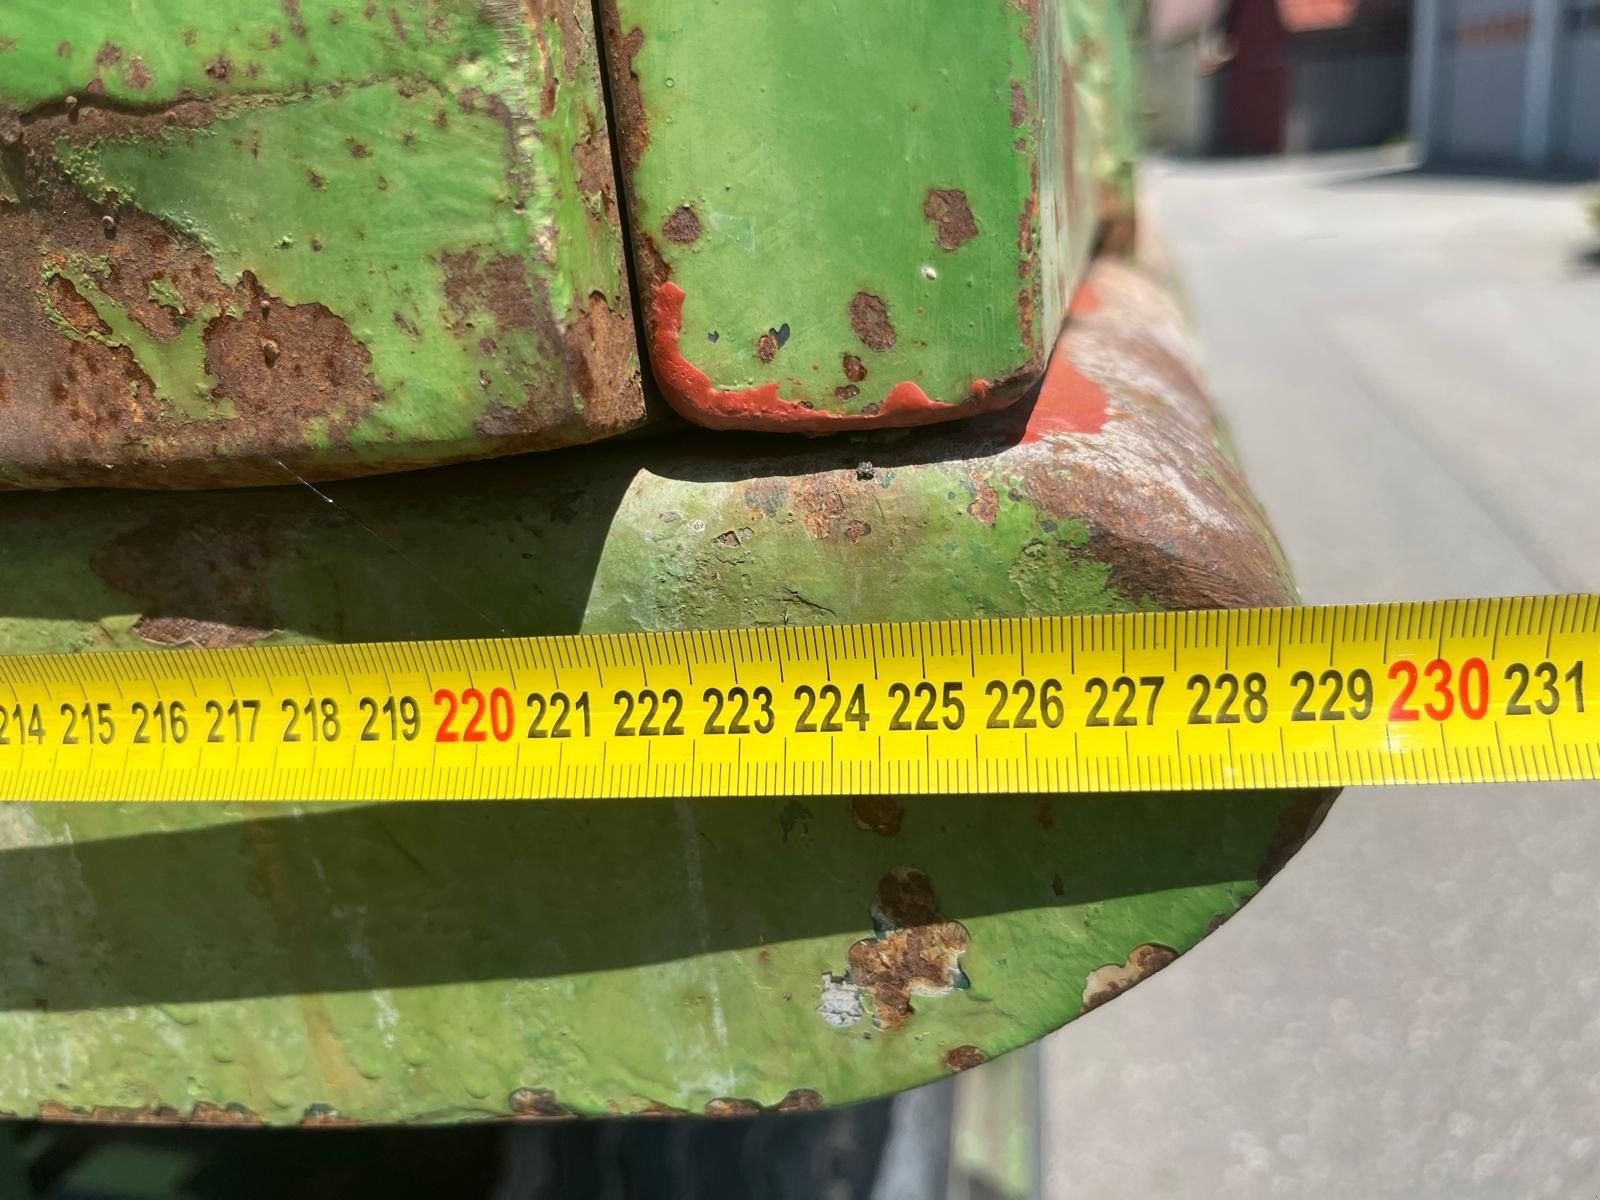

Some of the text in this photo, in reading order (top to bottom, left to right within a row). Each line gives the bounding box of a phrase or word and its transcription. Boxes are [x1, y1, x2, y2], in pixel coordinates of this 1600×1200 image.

[60, 702, 116, 744] 215
[132, 700, 188, 744] 216
[206, 700, 261, 743] 217
[281, 698, 341, 742] 218
[360, 696, 421, 742] 219
[434, 687, 515, 742] 220
[527, 691, 592, 738] 221
[614, 689, 684, 737] 222
[703, 686, 776, 735] 223
[794, 683, 870, 732] 224
[888, 682, 965, 731] 225
[985, 678, 1063, 728] 226
[1085, 676, 1165, 727] 227
[1187, 672, 1268, 724] 228
[1290, 669, 1374, 721] 229
[1387, 657, 1490, 722] 230
[1504, 660, 1585, 716] 231
